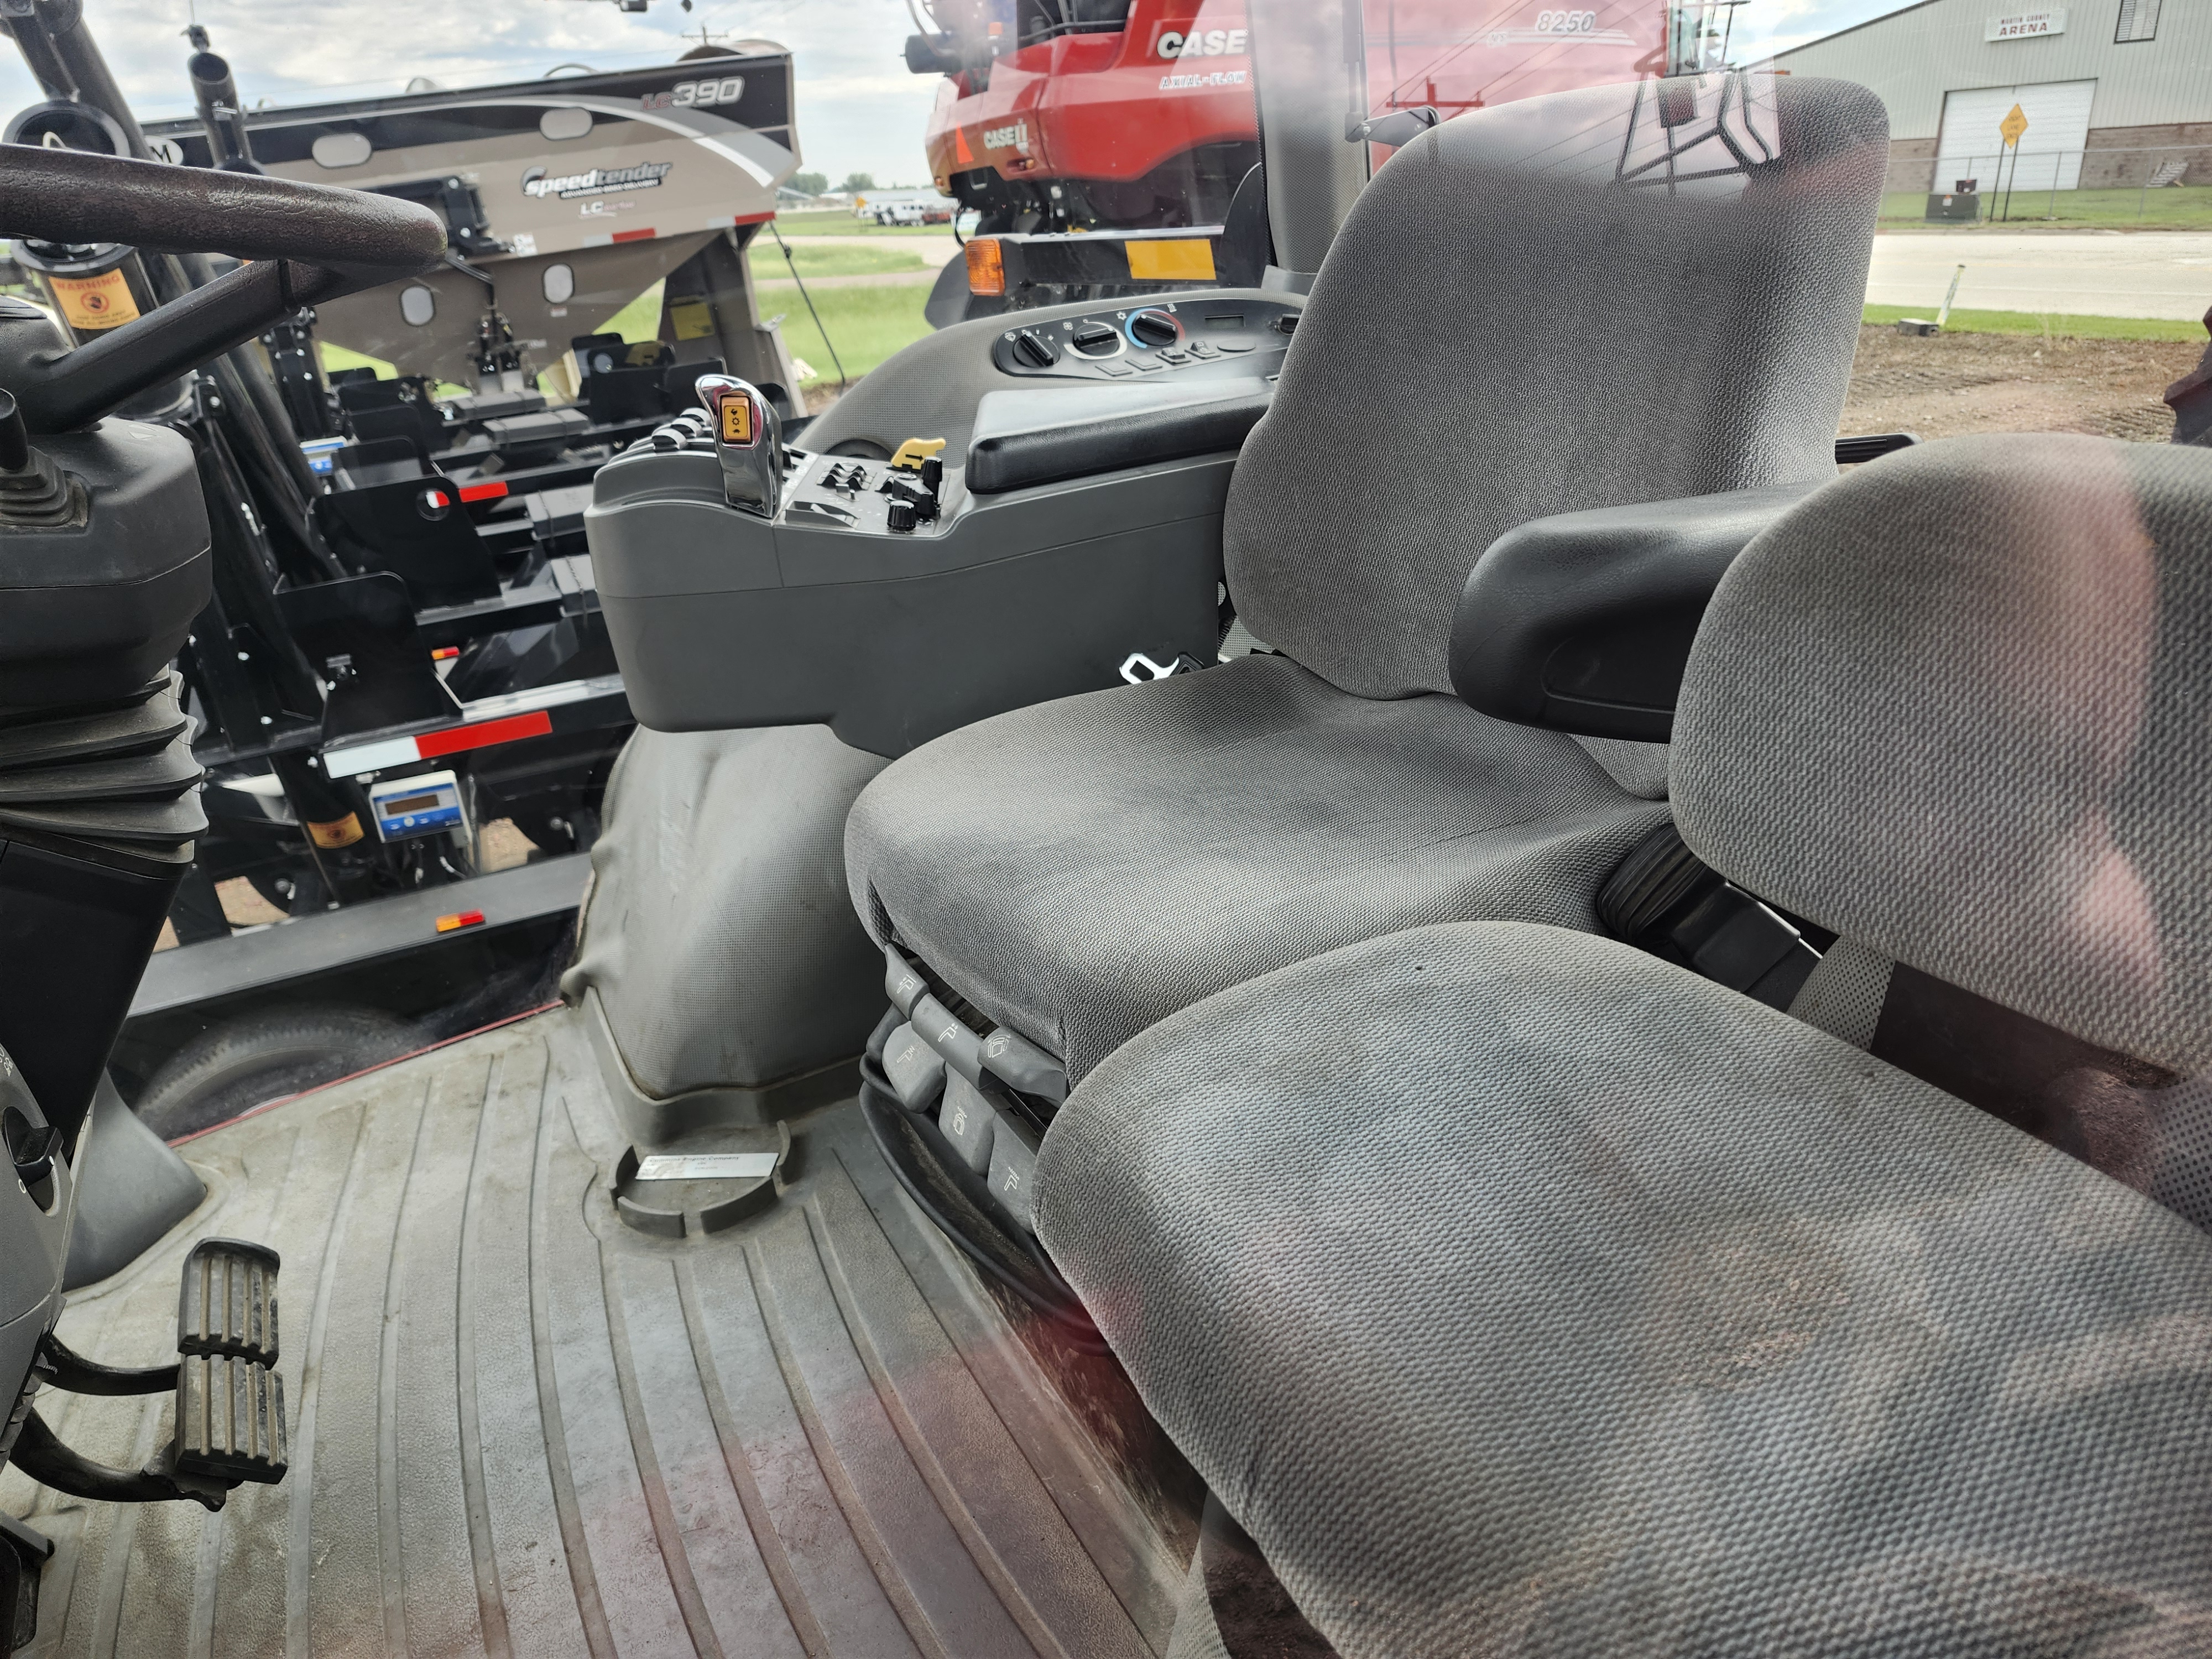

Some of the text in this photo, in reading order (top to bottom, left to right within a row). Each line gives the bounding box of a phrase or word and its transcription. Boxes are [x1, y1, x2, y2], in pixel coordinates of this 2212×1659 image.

[1535, 10, 1597, 33] 8250
[1999, 22, 2048, 36] ARENA
[1156, 29, 1248, 59] CASE
[1159, 70, 1247, 91] AXIAL-FLOW
[983, 126, 1015, 150] CASE
[56, 275, 120, 290] WARNING
